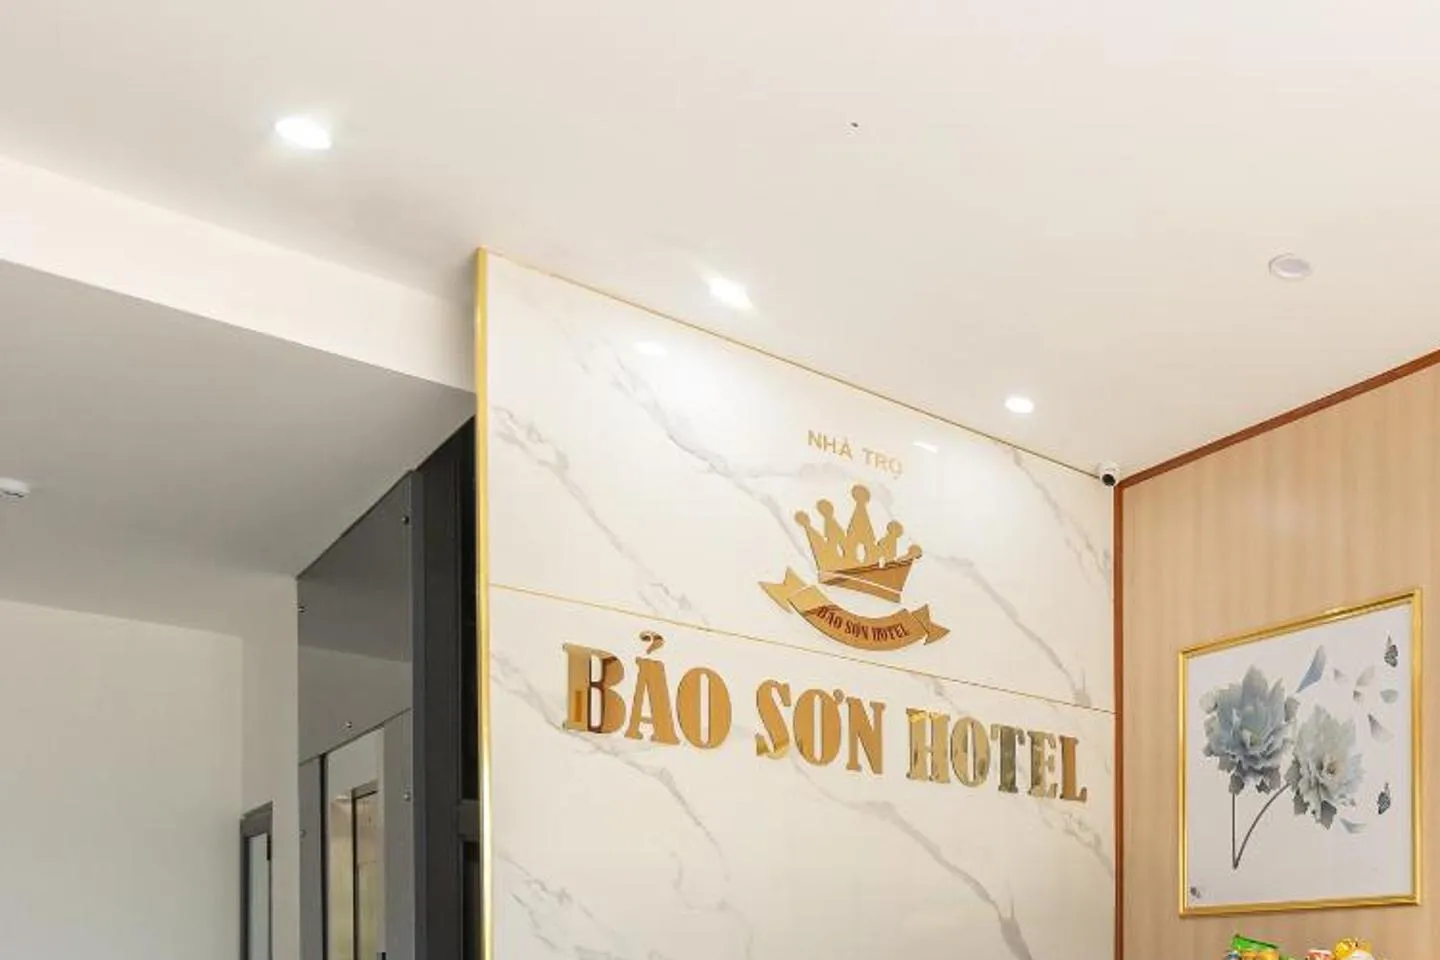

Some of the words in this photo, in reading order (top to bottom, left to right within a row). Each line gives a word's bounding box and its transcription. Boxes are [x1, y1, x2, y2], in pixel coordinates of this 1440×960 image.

[872, 623, 909, 641] HOTEL
[562, 631, 732, 750] BẢO
[755, 679, 886, 774] SƠN
[905, 708, 1087, 803] HOTEL
